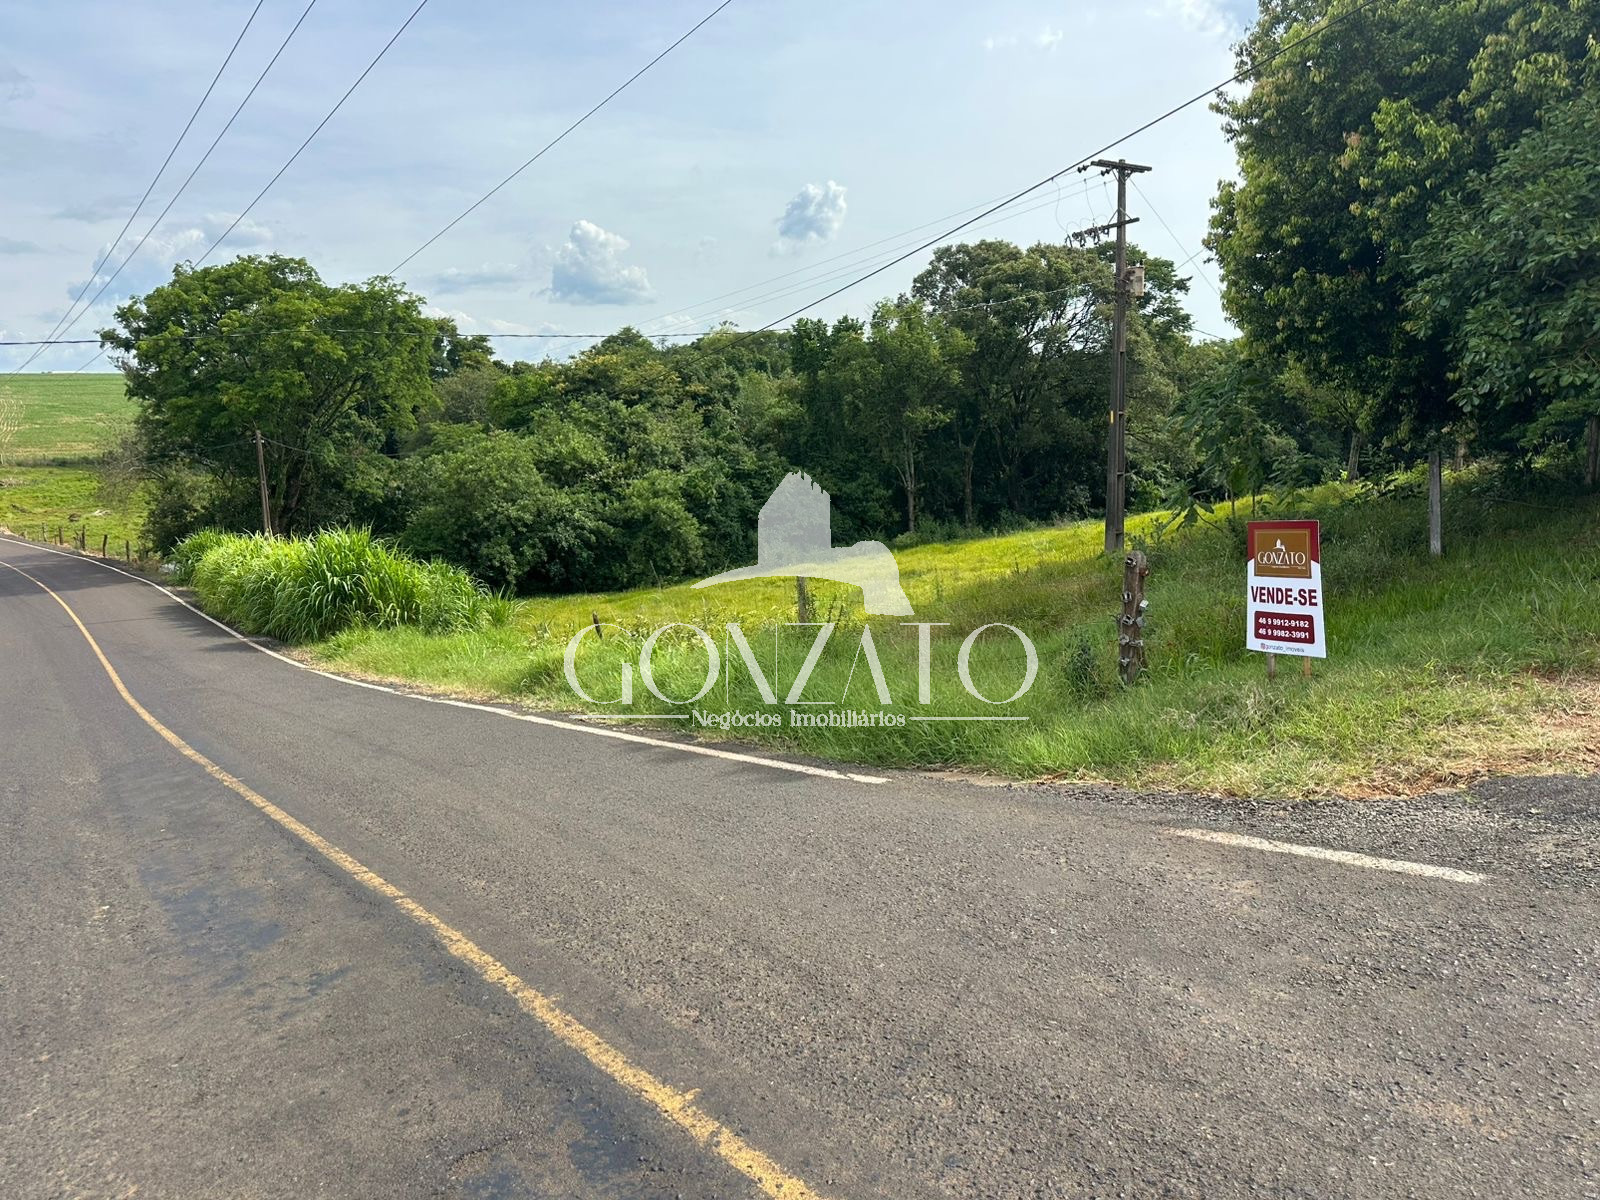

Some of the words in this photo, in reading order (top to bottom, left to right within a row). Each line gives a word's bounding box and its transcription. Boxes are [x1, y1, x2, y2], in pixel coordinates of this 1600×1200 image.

[1258, 551, 1305, 565] GONZATO
[1251, 586, 1318, 606] VENDE-SE
[1273, 619, 1309, 628] 9912-9182
[1273, 630, 1309, 639] 9982-3991
